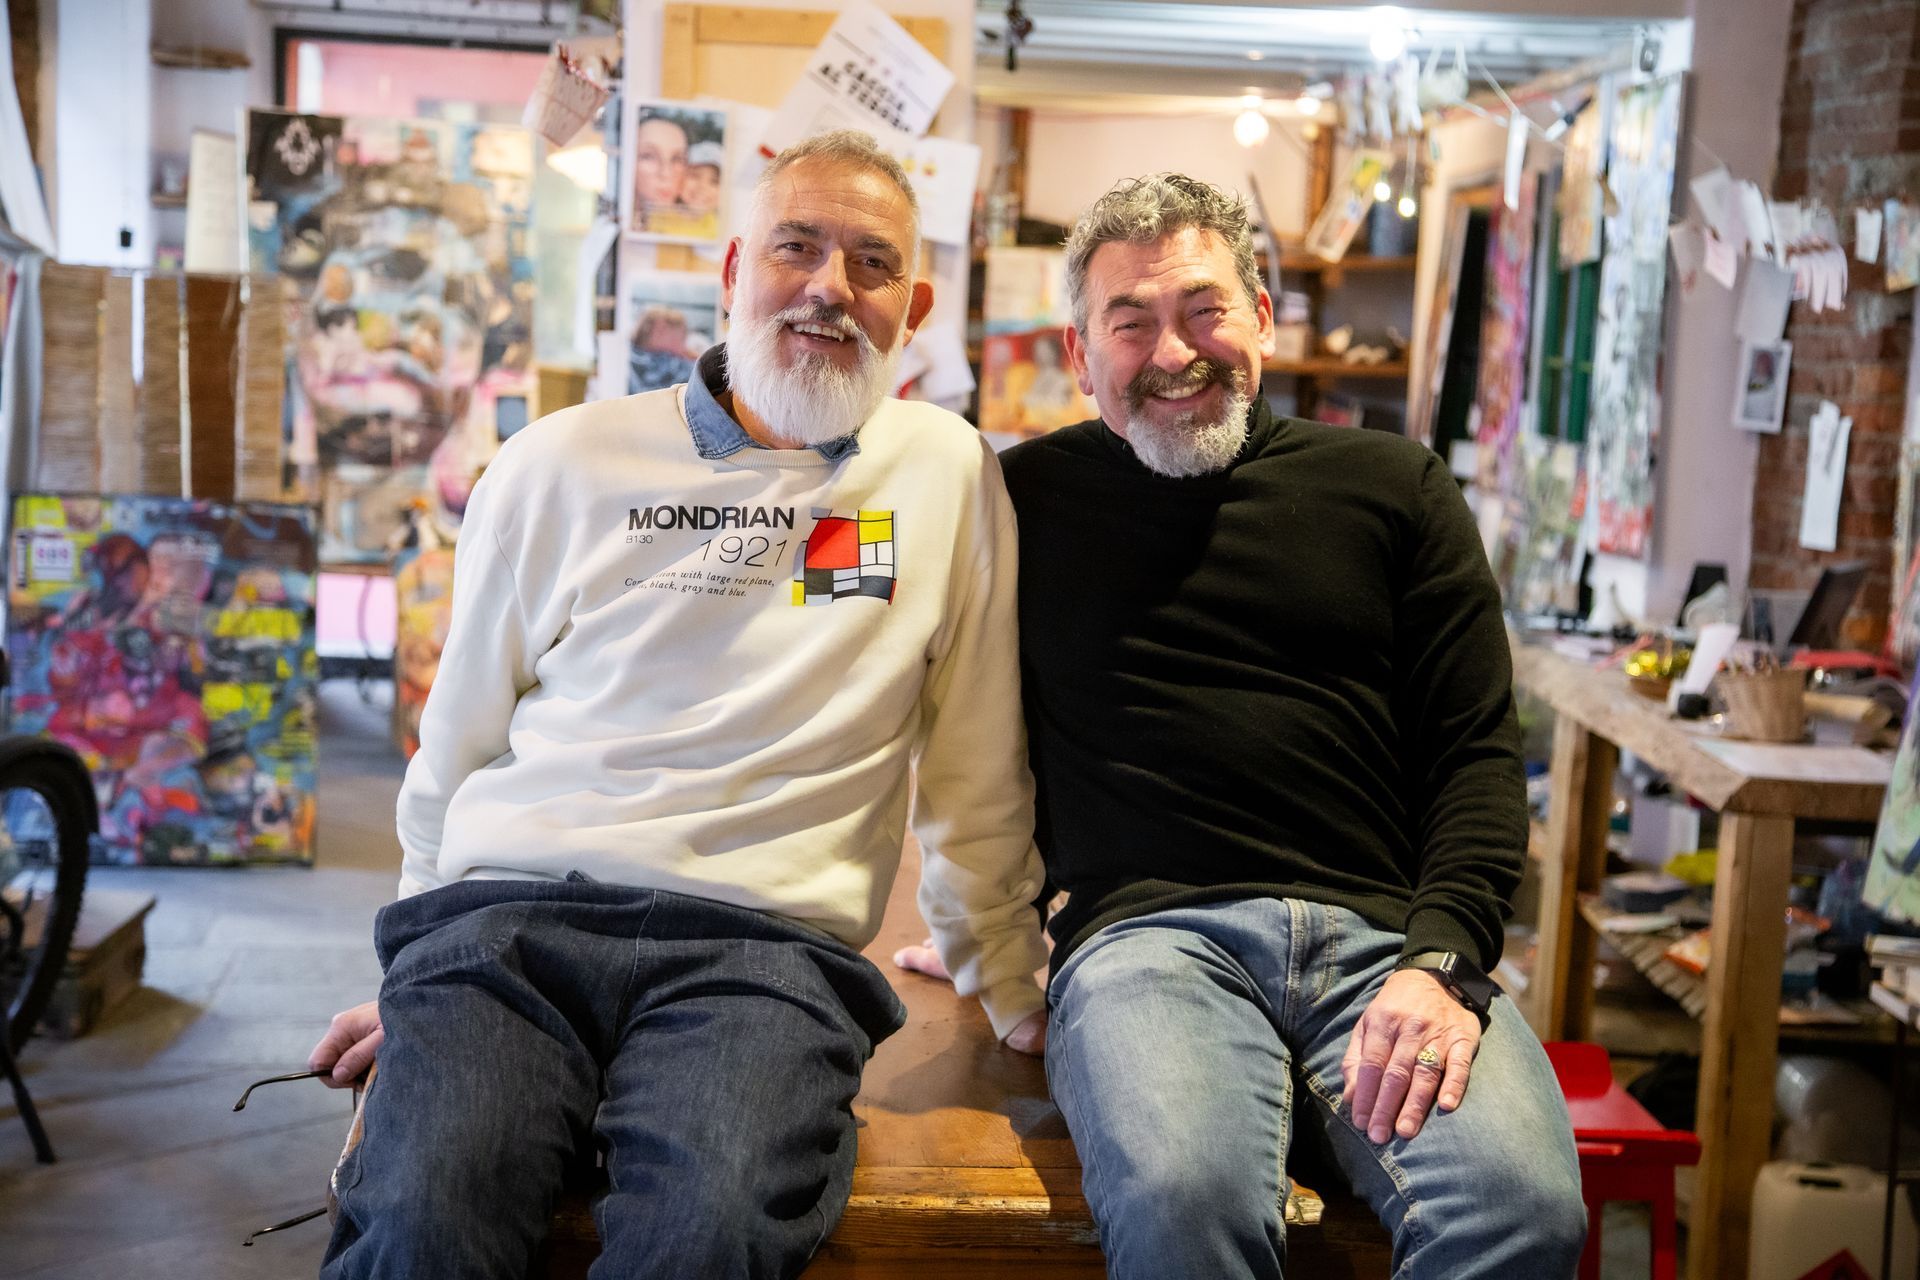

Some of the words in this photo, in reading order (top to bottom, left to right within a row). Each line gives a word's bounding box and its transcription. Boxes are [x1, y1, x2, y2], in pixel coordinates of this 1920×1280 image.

[628, 505, 795, 530] MONDRIAN
[625, 534, 653, 544] B130
[700, 536, 787, 567] 1921
[680, 570, 702, 579] with
[706, 571, 731, 585] large
[734, 576, 749, 585] red
[748, 576, 775, 587] plane,
[649, 580, 677, 591] black,
[680, 584, 704, 595] gray
[707, 587, 727, 596] and
[728, 587, 747, 597] blue.
